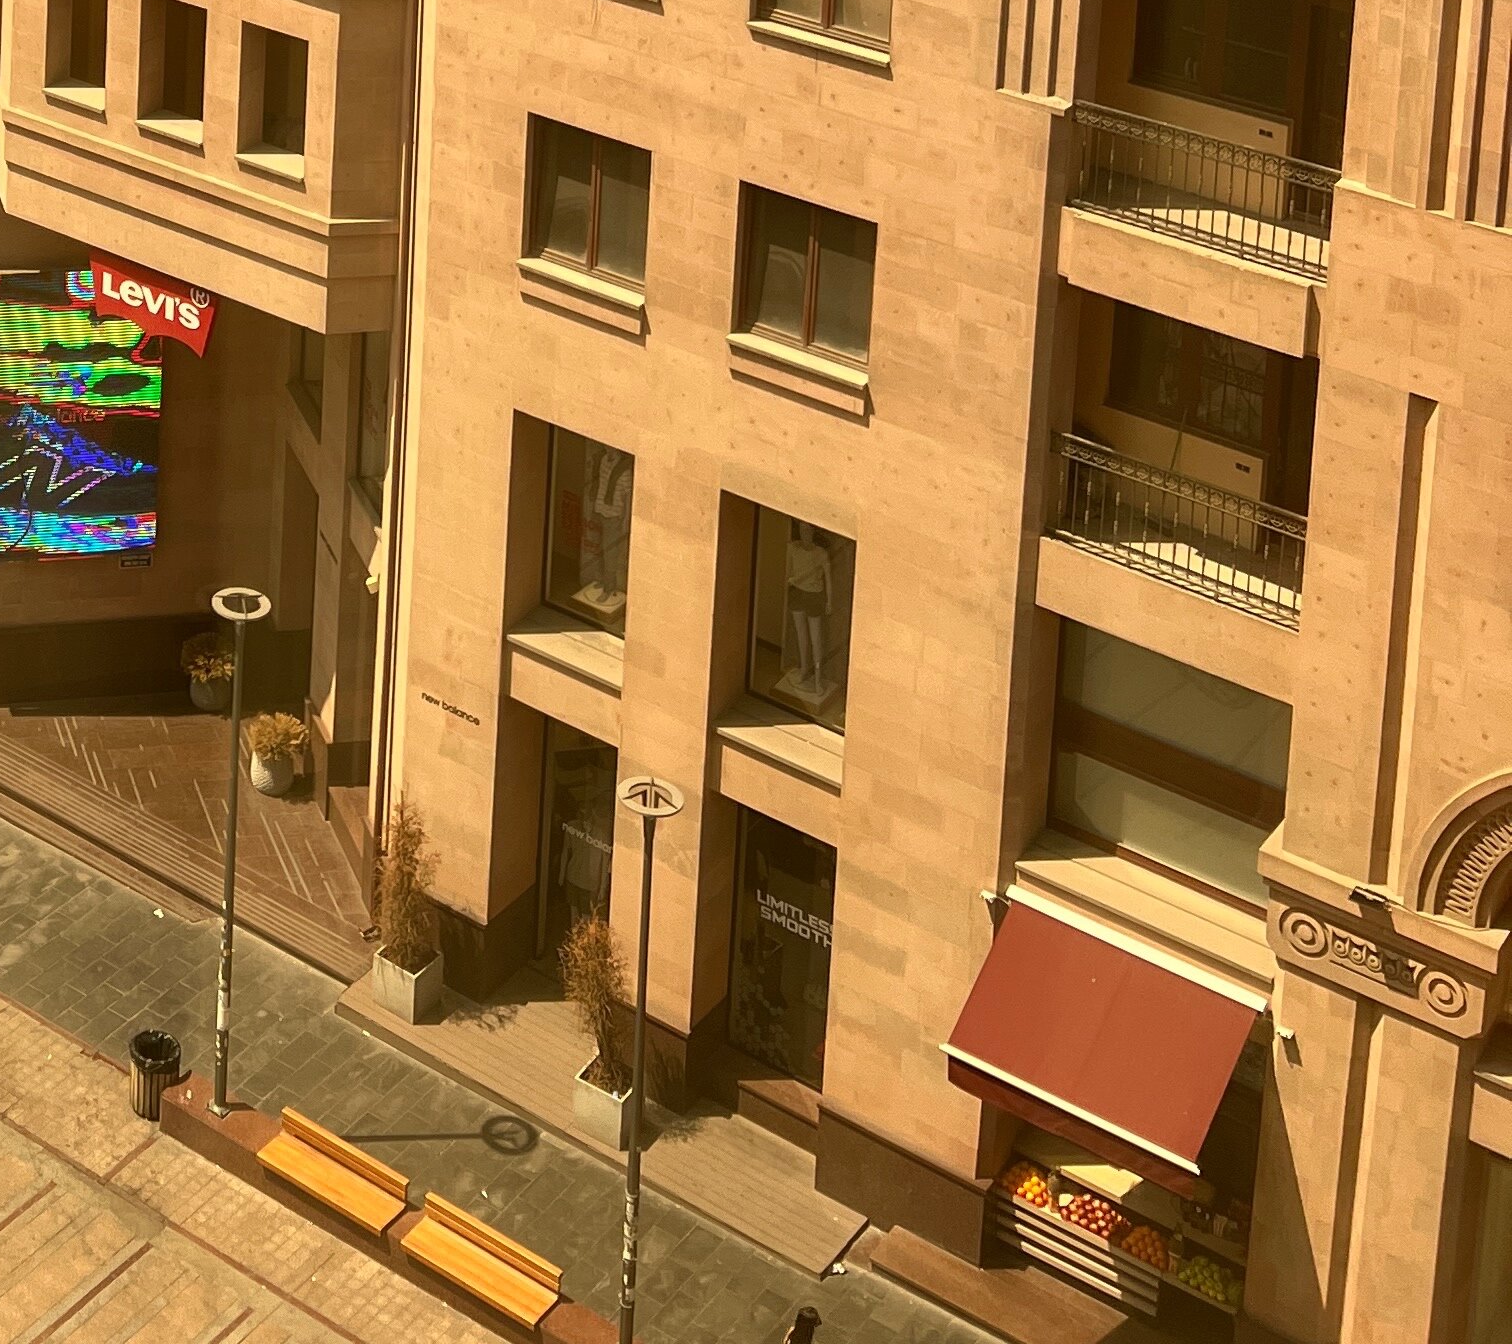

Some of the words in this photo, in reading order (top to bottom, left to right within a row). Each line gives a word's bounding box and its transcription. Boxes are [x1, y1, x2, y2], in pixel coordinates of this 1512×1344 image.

[421, 692, 440, 706] new
[442, 700, 480, 726] balance
[562, 823, 584, 839] new
